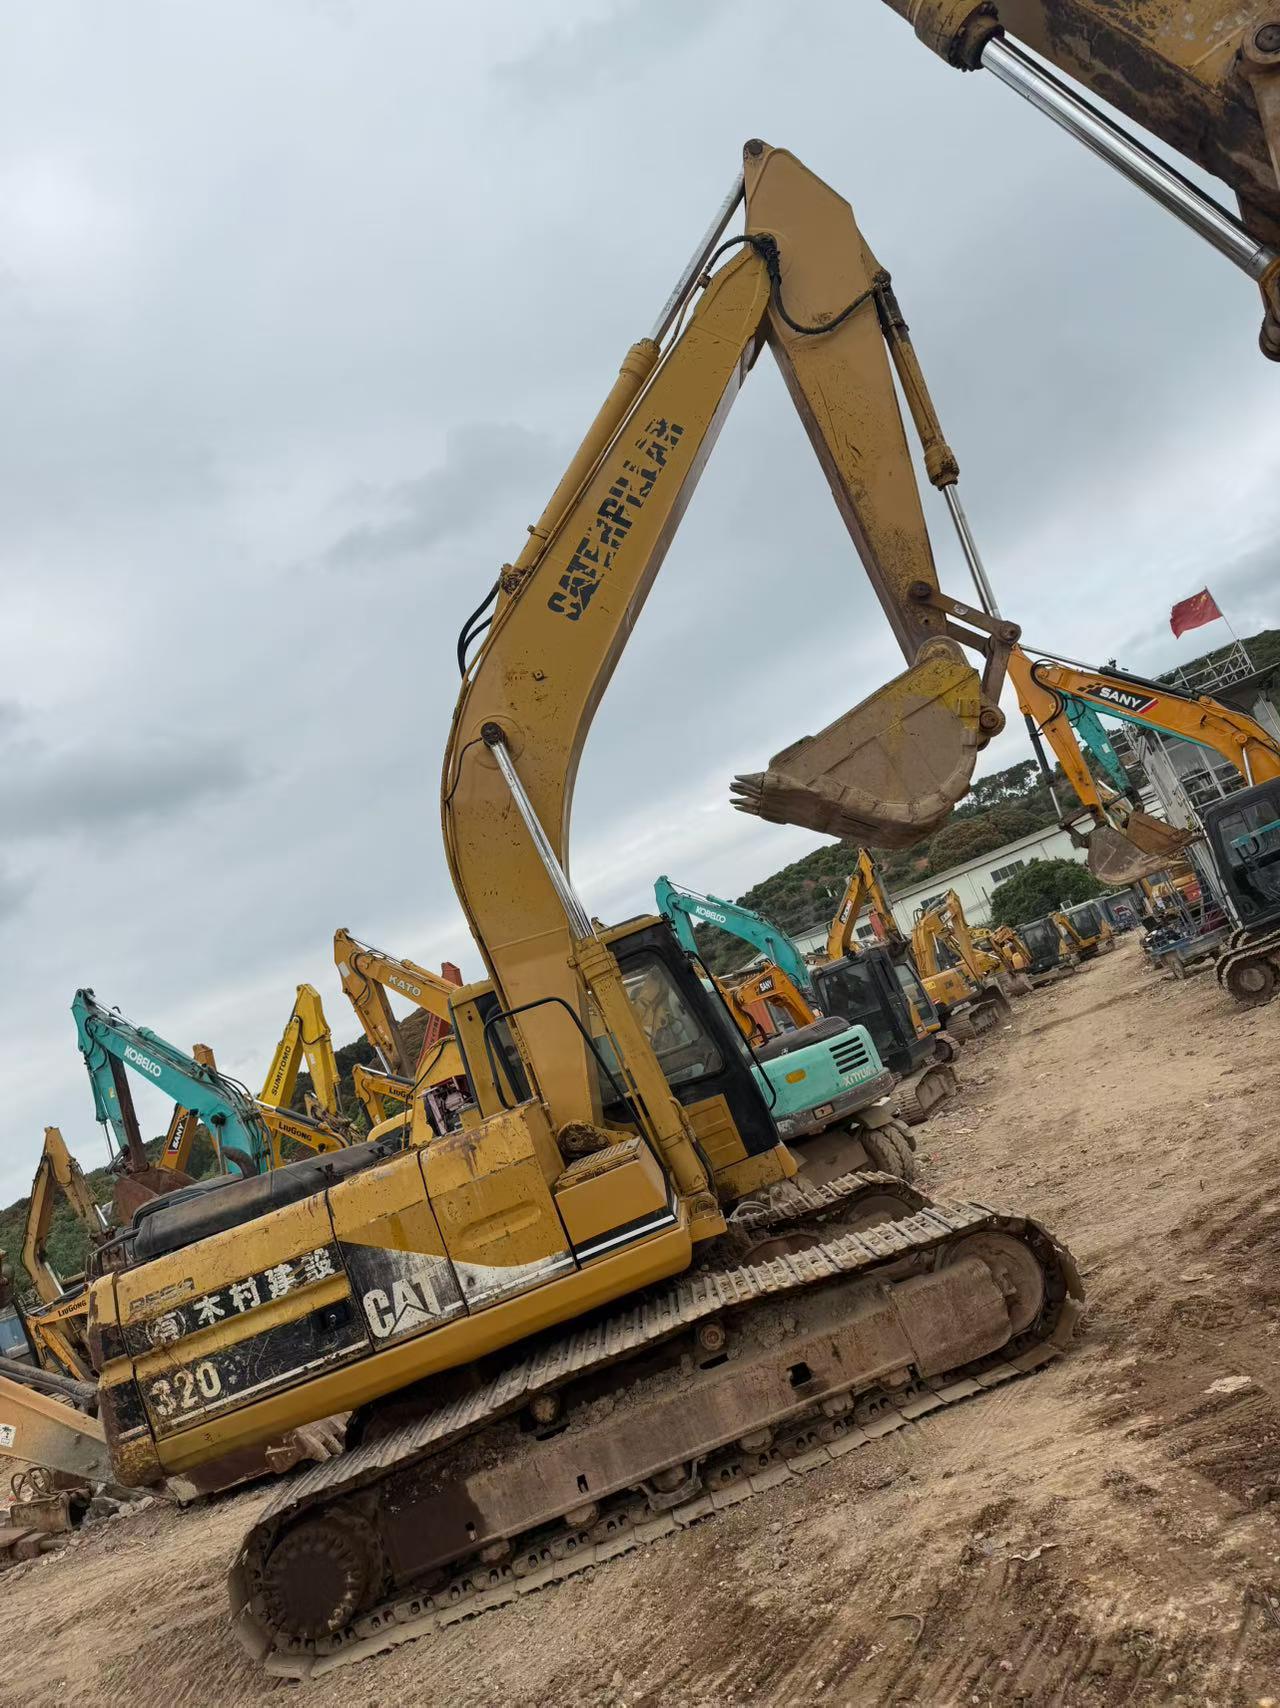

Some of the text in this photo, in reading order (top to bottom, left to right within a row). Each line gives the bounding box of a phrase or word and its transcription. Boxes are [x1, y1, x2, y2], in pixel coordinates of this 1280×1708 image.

[1099, 687, 1142, 708] SANY
[695, 905, 727, 924] KOBELCO
[388, 974, 422, 997] KATO
[759, 979, 773, 992] SANY
[124, 1045, 162, 1078] KOBELCO
[271, 1045, 292, 1097] SUMITOMO
[172, 1122, 185, 1150] SANY
[363, 1261, 447, 1338] CAT
[150, 1361, 222, 1416] 320
